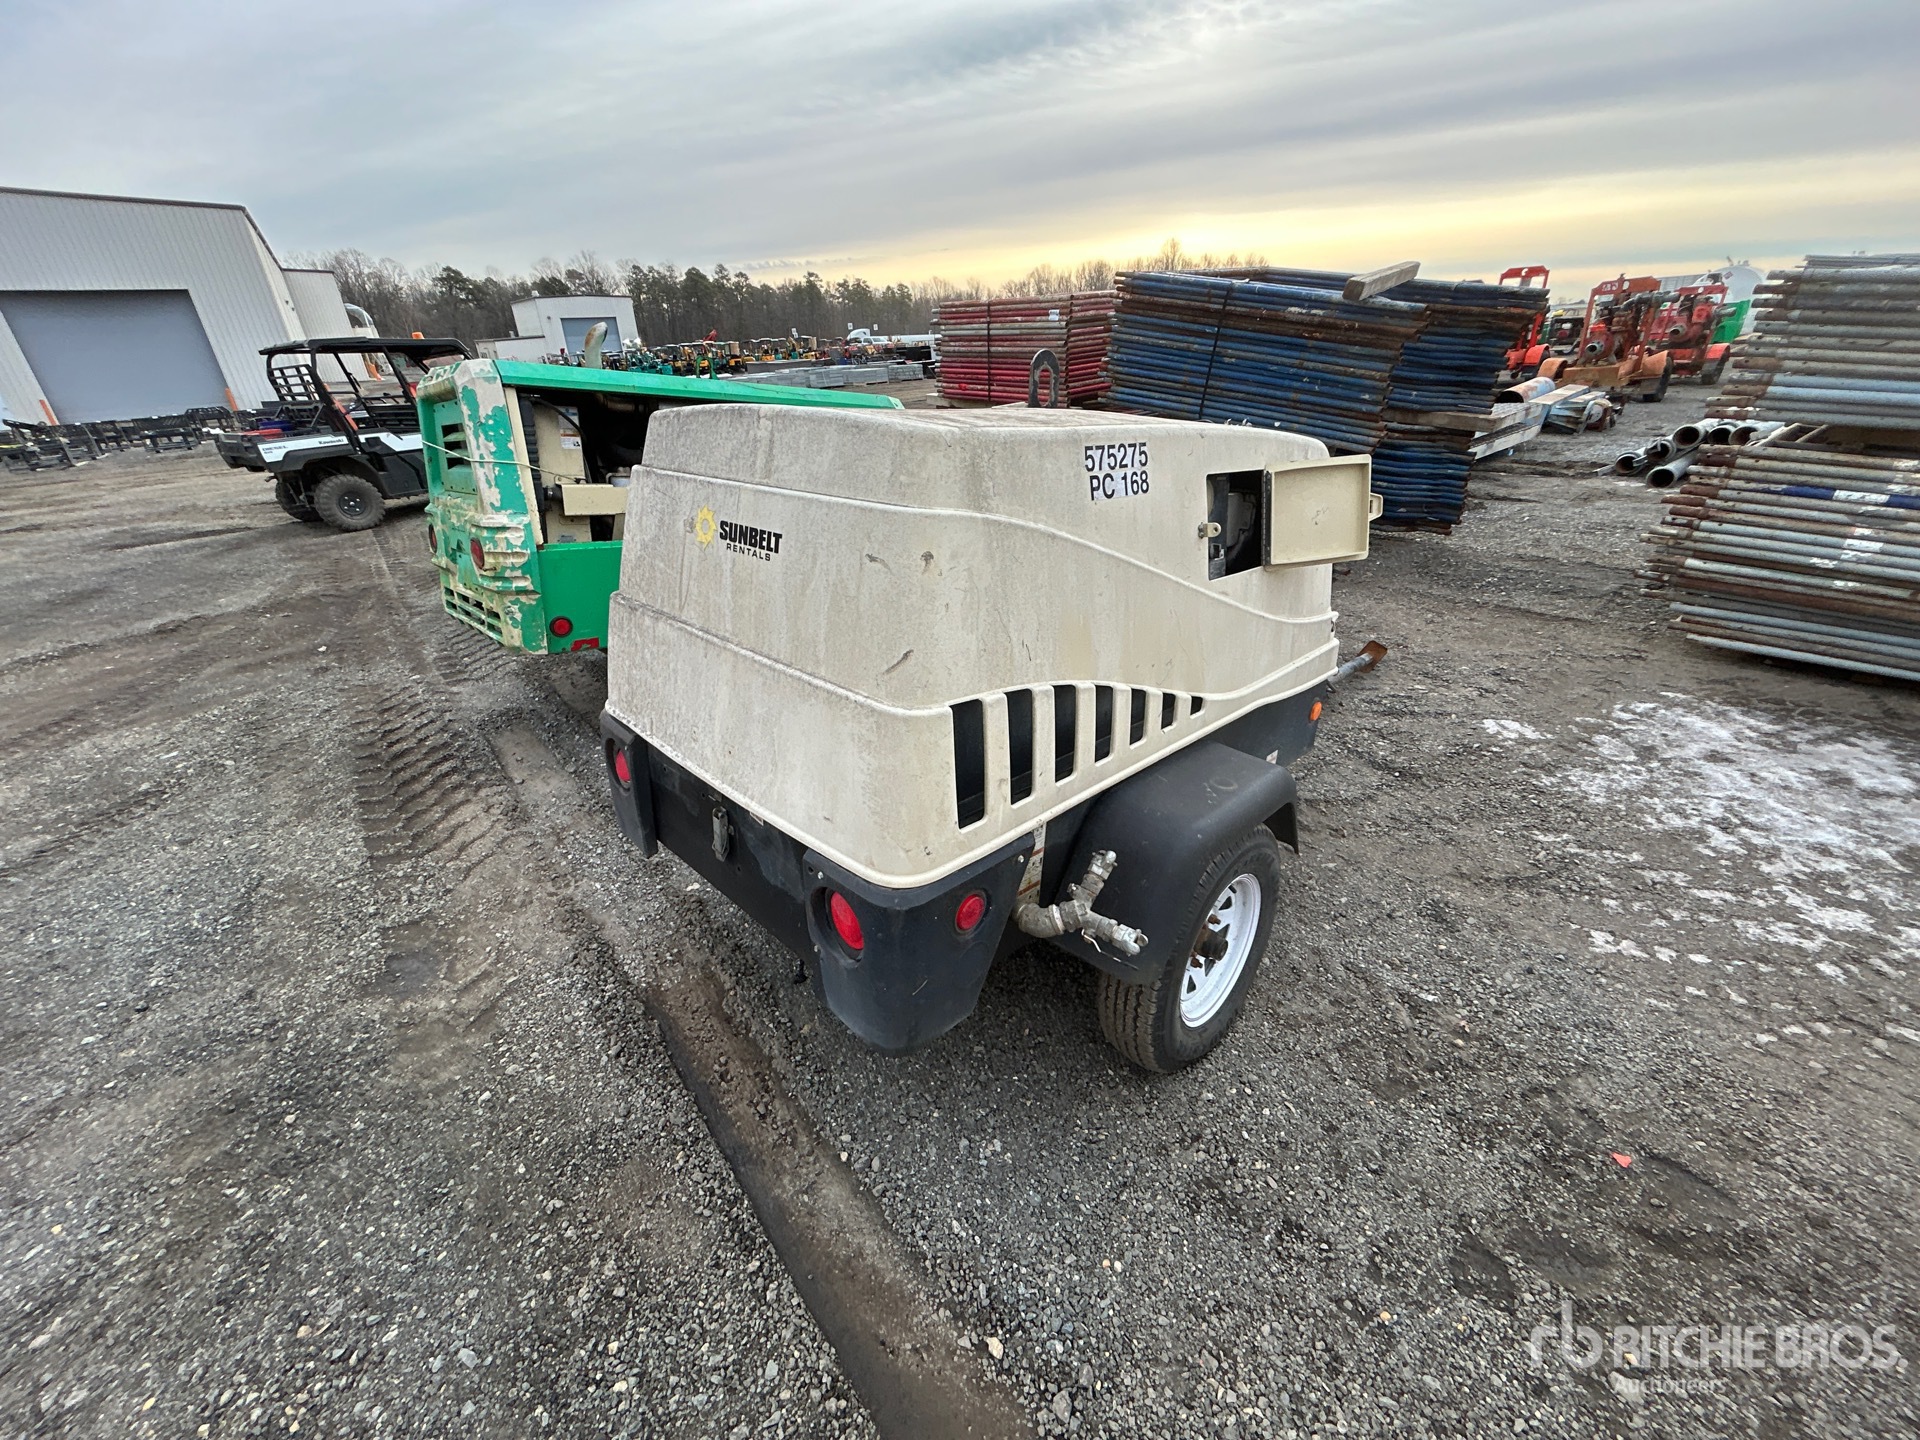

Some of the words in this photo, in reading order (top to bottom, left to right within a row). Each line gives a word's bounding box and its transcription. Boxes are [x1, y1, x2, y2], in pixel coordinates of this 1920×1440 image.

[1084, 442, 1148, 472] 575275
[1089, 473, 1115, 501] PC
[1121, 470, 1149, 496] 168
[719, 520, 783, 554] SUNBELT
[726, 543, 771, 561] RENTALS
